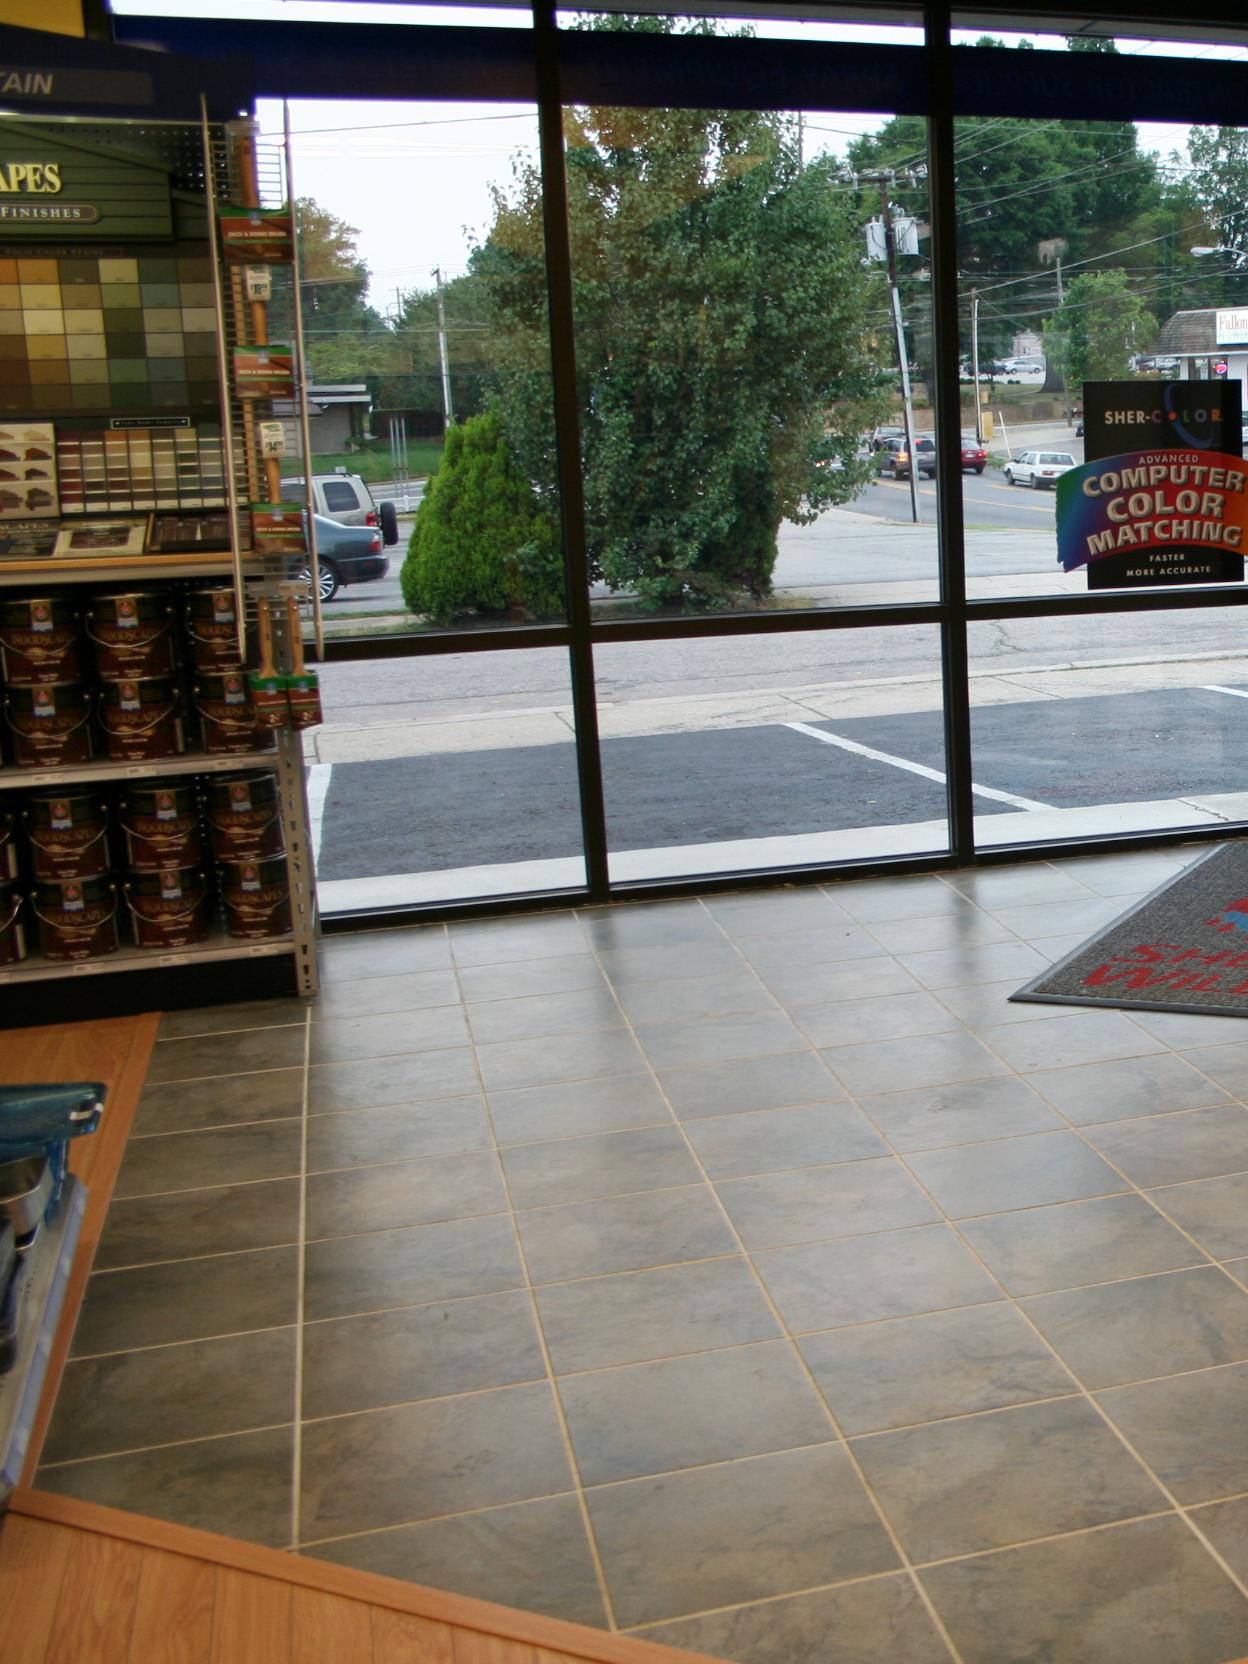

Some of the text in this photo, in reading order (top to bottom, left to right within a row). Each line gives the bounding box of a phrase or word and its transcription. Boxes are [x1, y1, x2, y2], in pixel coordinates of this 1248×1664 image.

[1, 207, 81, 218] FINISHES
[1138, 454, 1199, 465] ADVANCED
[1082, 465, 1247, 498] COMPUTER
[1106, 490, 1226, 523] COLOR
[1086, 520, 1243, 556] MATCHING
[1149, 553, 1185, 562] FASTER
[1126, 566, 1211, 577] MORE ACCURATE
